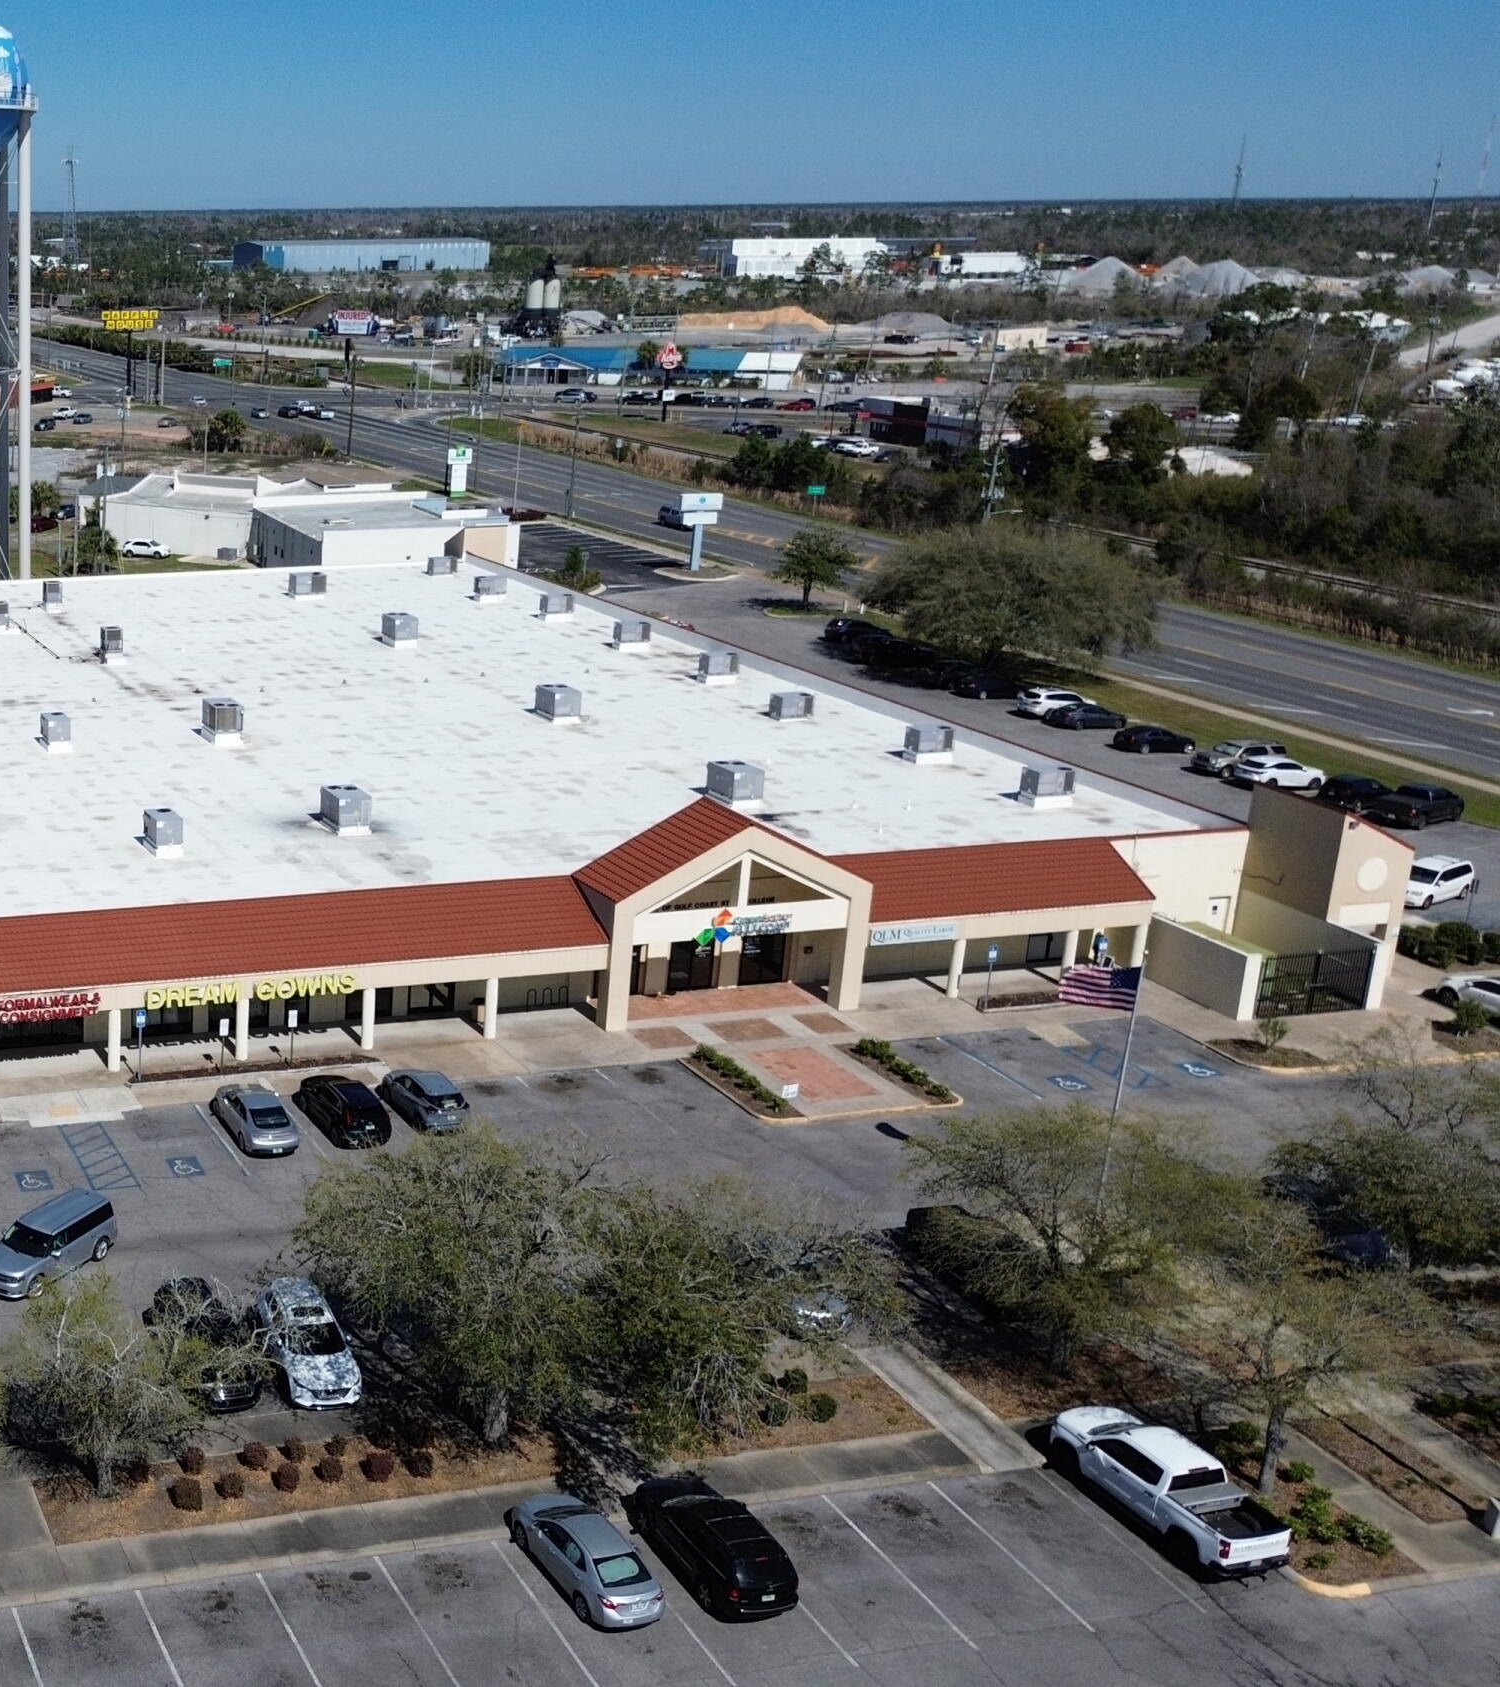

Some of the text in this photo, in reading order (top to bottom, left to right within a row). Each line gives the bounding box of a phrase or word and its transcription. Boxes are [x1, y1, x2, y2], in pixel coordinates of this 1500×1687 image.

[102, 311, 158, 320] WAFFLE
[106, 320, 153, 329] HOUSE
[748, 896, 775, 904] OLLEGE
[872, 928, 901, 943] QLM
[146, 972, 356, 1010] DREAM GOWNS
[92, 992, 101, 1003] &
[0, 1006, 99, 1024] CONSIGNMENT
